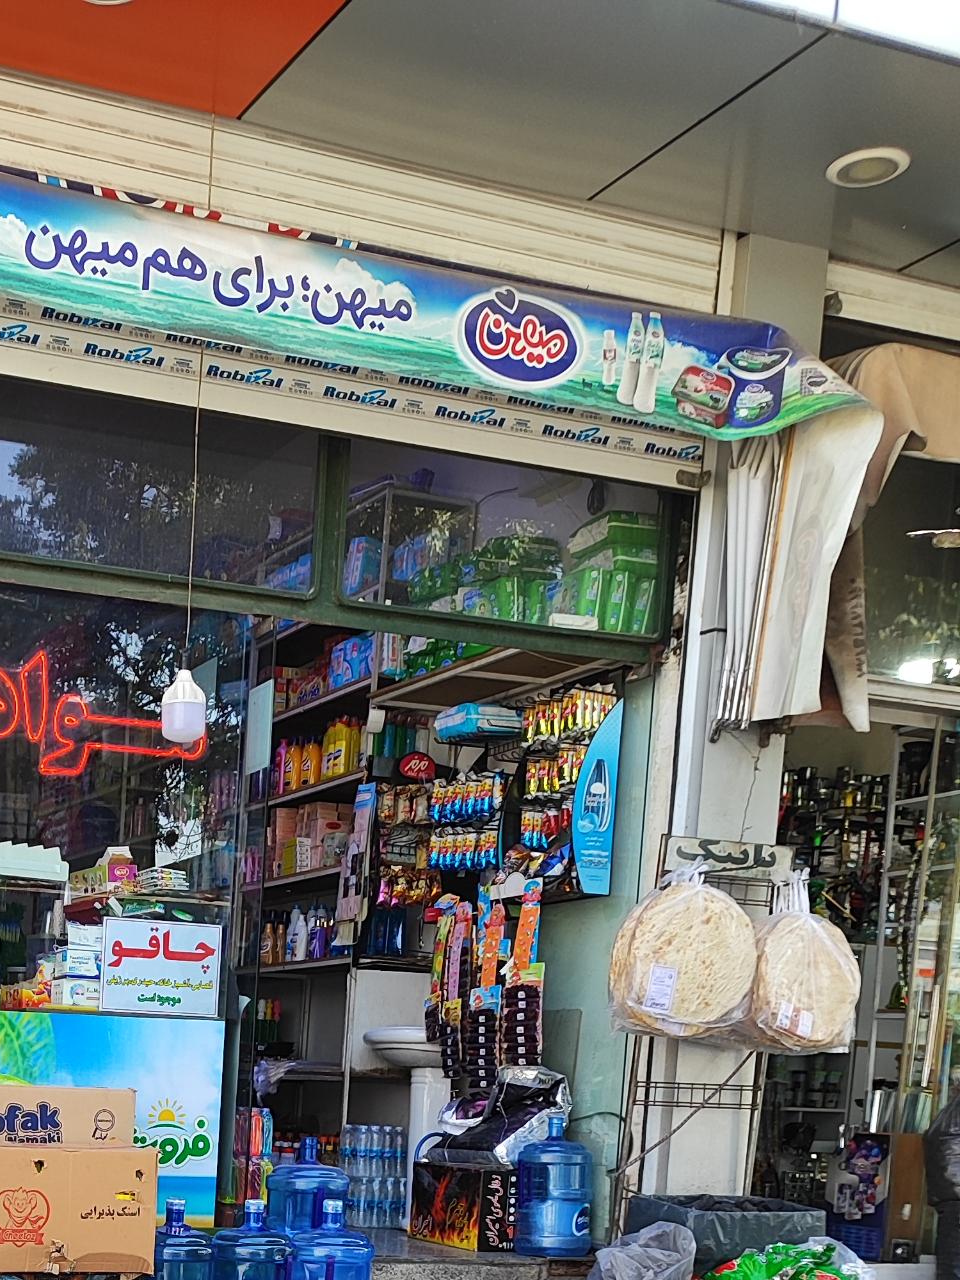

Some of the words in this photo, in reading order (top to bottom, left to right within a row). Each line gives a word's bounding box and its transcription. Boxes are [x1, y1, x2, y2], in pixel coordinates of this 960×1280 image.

[24, 223, 138, 276] میهن
[141, 243, 208, 294] هم
[212, 254, 295, 321] برای
[476, 303, 569, 369] میهن
[107, 926, 217, 975] چاقو
[137, 992, 157, 1003] است
[156, 993, 182, 1007] موجود
[80, 1205, 116, 1221] پذیرایی
